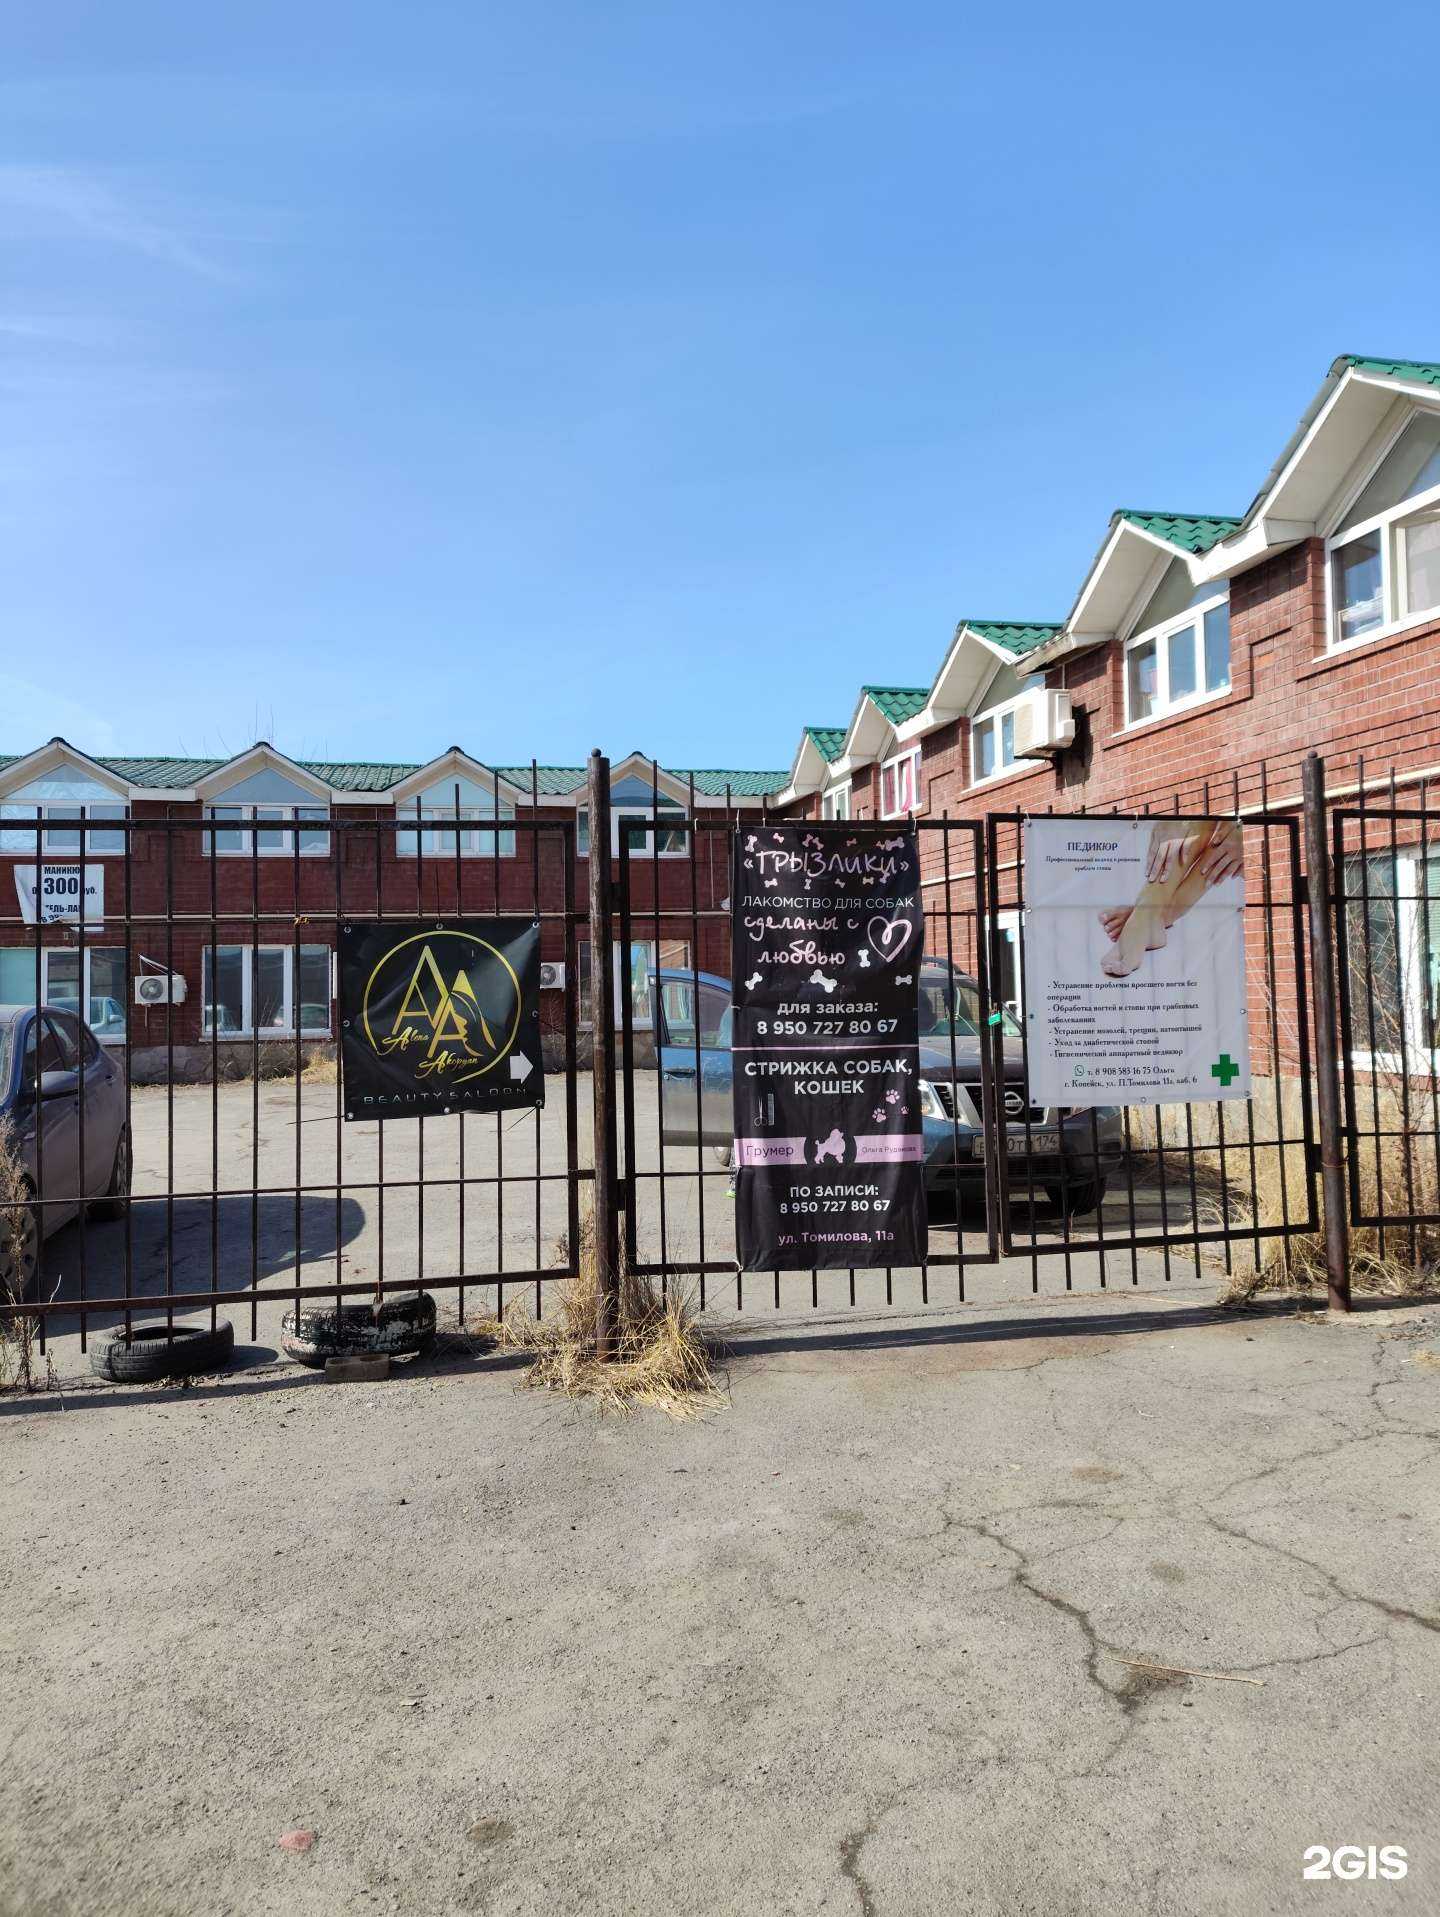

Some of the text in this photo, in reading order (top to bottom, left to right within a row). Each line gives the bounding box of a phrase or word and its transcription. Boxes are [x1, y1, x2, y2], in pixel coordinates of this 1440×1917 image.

[1067, 842, 1118, 852] ПЕДИКЮР
[44, 866, 84, 875] МАНИКЮ
[44, 877, 79, 895] 300
[742, 896, 914, 910] ЛАКОМСТВО ДЛЯ СОБАК
[744, 916, 860, 941] сделаны с
[1053, 980, 1093, 990] Устранение
[1095, 981, 1130, 990] проблемы
[1047, 994, 1081, 1002] операции
[777, 1002, 878, 1015] для заказа:
[1053, 1003, 1092, 1013] Обработка
[757, 1019, 898, 1035] 8 950 727 80 67
[1054, 1026, 1094, 1036] Устранение
[1054, 1038, 1073, 1046] Уход
[1083, 1038, 1134, 1047] диабетической
[1108, 1049, 1152, 1058] аппаратный
[745, 1059, 913, 1076] СТРИЖКА СОБАК,
[1133, 1067, 1141, 1075] 16
[1143, 1066, 1151, 1074] 75
[1153, 1066, 1175, 1074] Ольга
[795, 1080, 865, 1095] КОШЕК
[746, 1144, 795, 1159] Грумер
[790, 1184, 879, 1198] ПО ЗАПИСИ:
[780, 1199, 890, 1214] 8 950 727 80 67
[778, 1230, 894, 1247] ул. Томилова, 11а
